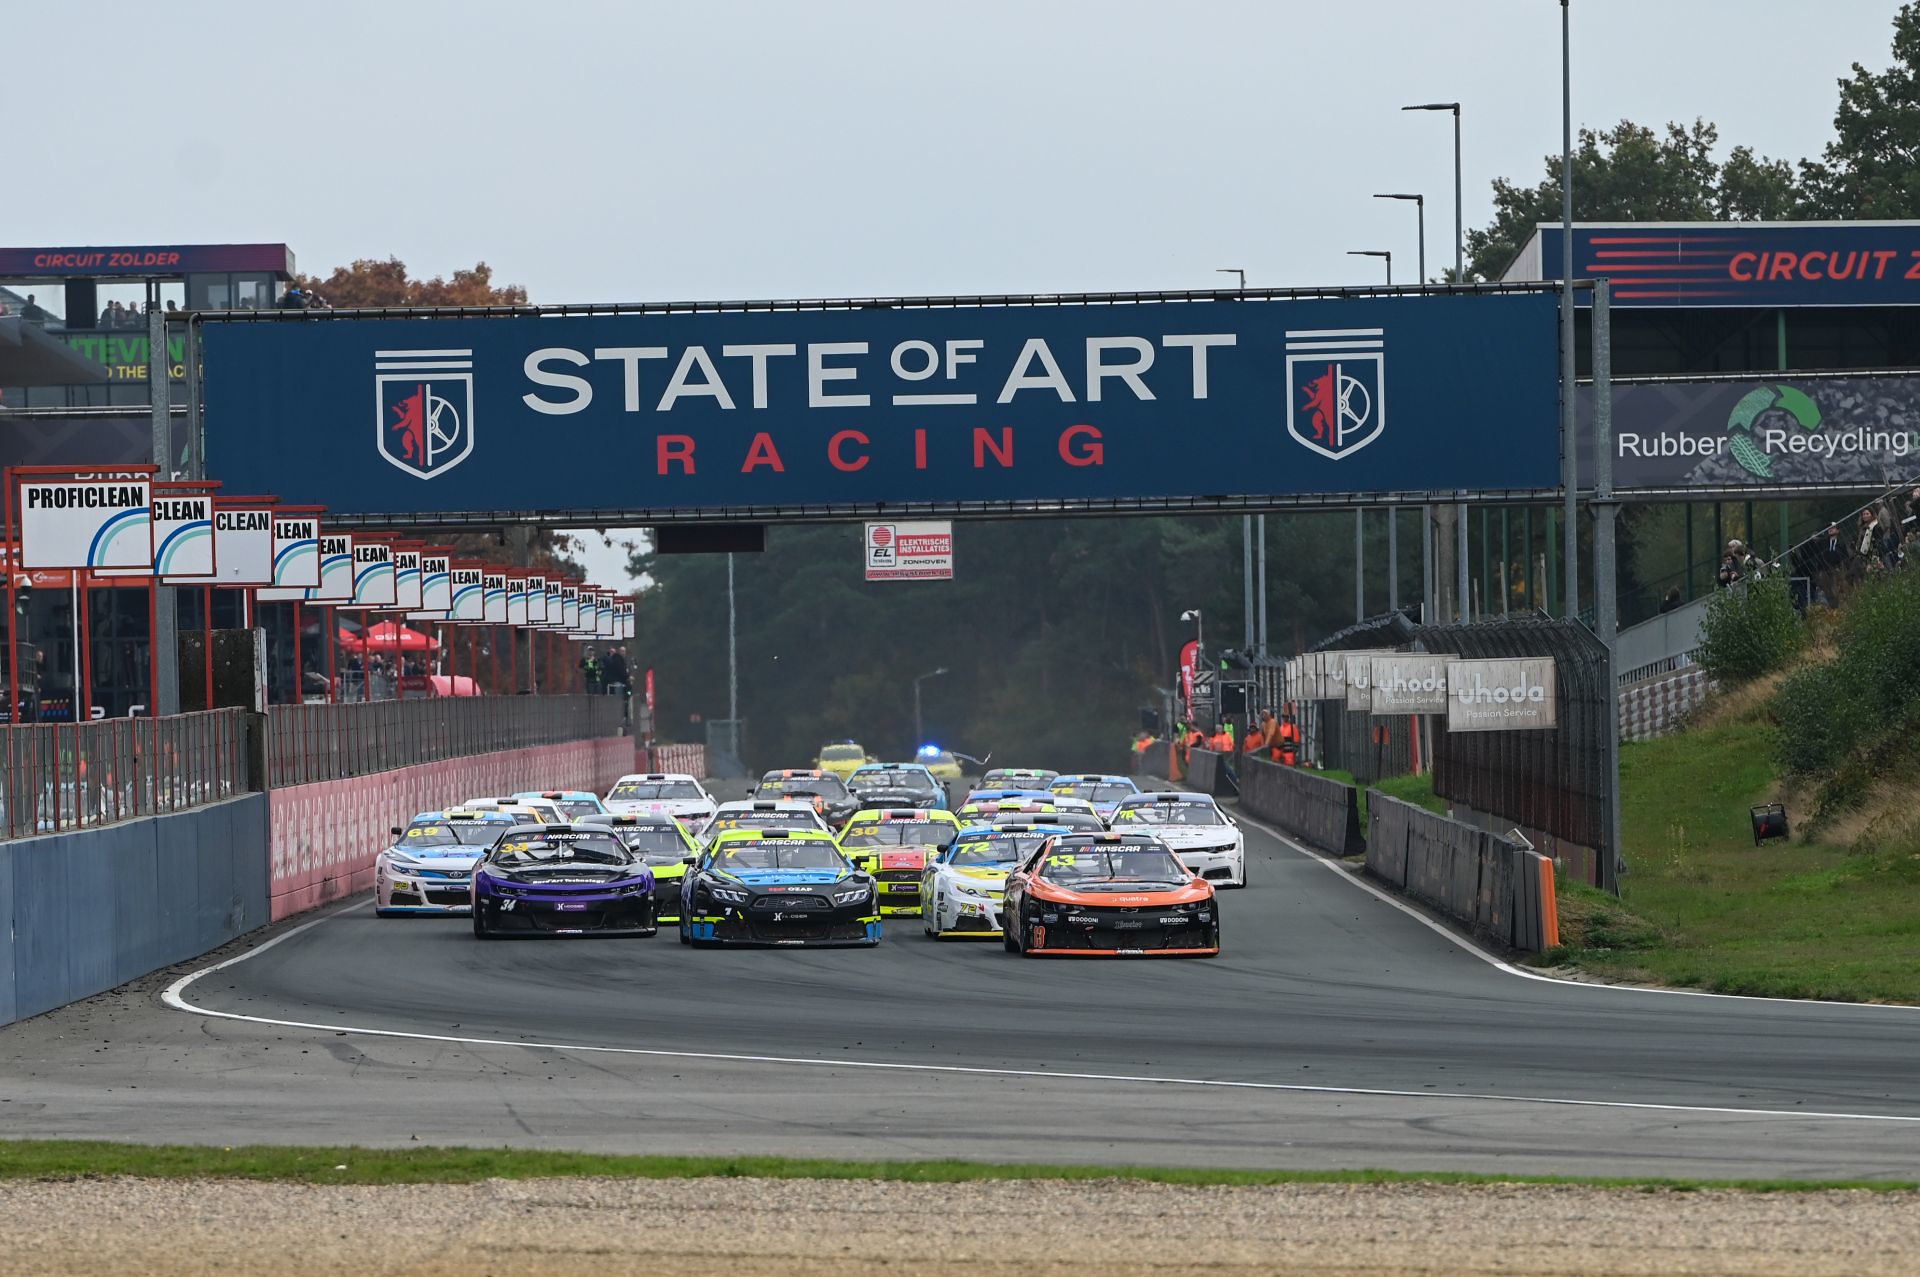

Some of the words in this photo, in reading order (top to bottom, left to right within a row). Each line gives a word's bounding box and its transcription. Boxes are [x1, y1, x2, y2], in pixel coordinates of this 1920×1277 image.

[34, 253, 104, 268] CIRCUIT
[107, 252, 181, 267] ZOLDER
[1728, 250, 1897, 281] CIRCUIT
[116, 365, 147, 379] THE
[522, 342, 871, 416] STATE
[890, 339, 984, 381] OF
[996, 333, 1237, 404] ART
[1618, 431, 1727, 458] Rubber
[1765, 427, 1909, 458] Recycling
[656, 424, 1104, 475] RACING
[28, 486, 143, 509] PROFICLEAN
[215, 512, 269, 531] CLEAN
[899, 538, 950, 546] ELEKTRISCHE
[873, 548, 892, 557] EL
[899, 545, 950, 553] INSTALLATIES
[1458, 671, 1545, 705] uhoda
[1385, 695, 1415, 704] Passion
[1466, 708, 1501, 719] Passion
[1503, 708, 1537, 718] Service
[762, 781, 784, 789] 55
[406, 827, 439, 838] 69
[849, 827, 879, 837] 30
[500, 843, 529, 853] 34
[724, 848, 738, 859] 7
[958, 841, 990, 854] 72
[1094, 845, 1141, 853] NASCAR
[1046, 854, 1077, 867] 13
[500, 899, 516, 912] 34
[724, 907, 732, 916] 7
[960, 902, 978, 914] 72
